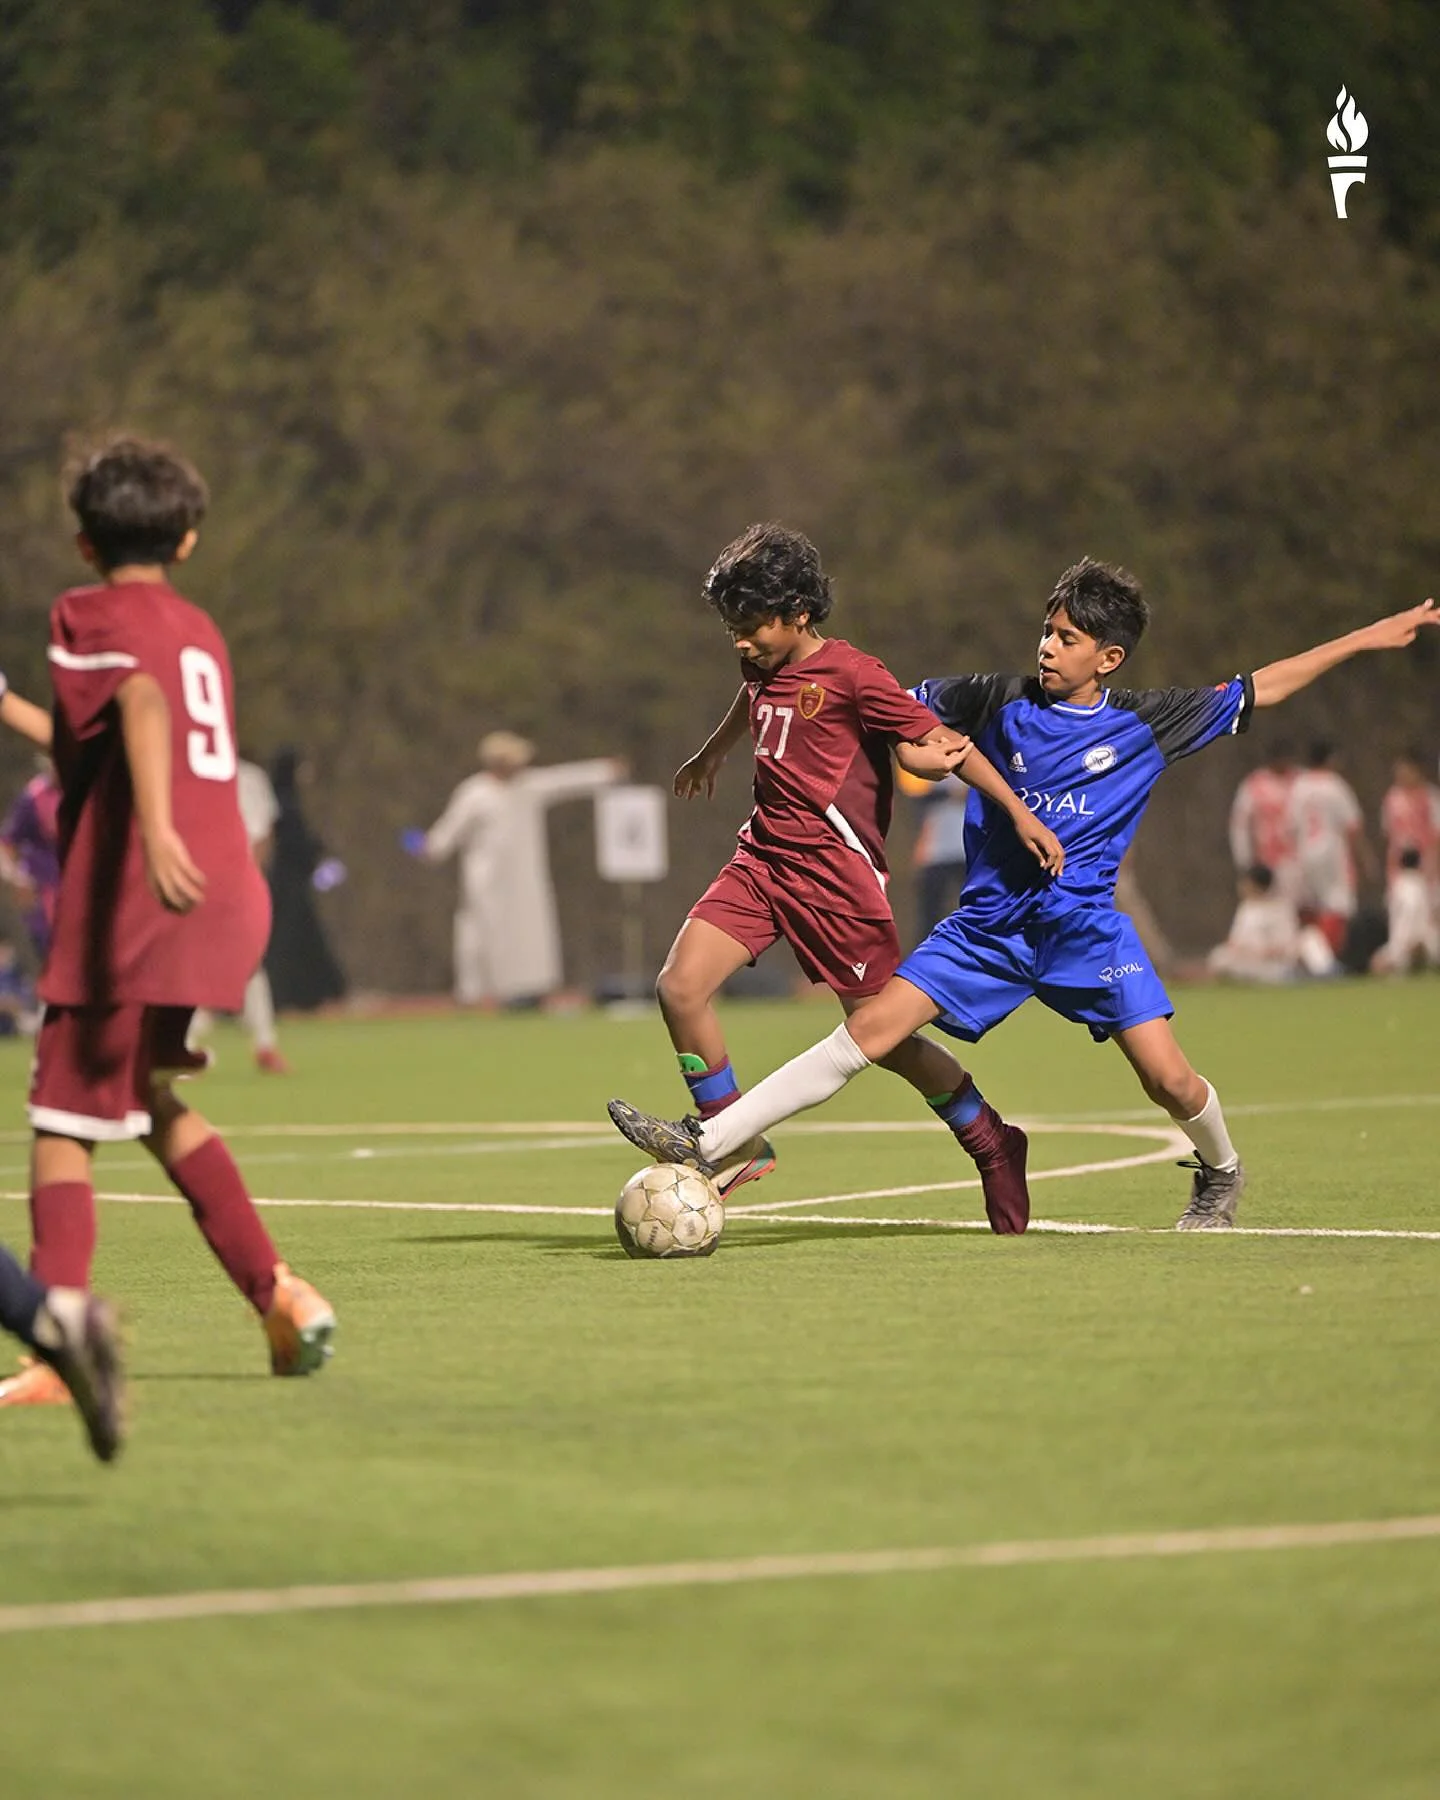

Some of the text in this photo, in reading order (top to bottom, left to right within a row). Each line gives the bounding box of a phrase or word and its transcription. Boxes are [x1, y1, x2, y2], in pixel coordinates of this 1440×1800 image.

[179, 645, 236, 782] 9
[754, 703, 793, 759] 27
[1098, 962, 1143, 983] ROYAL
